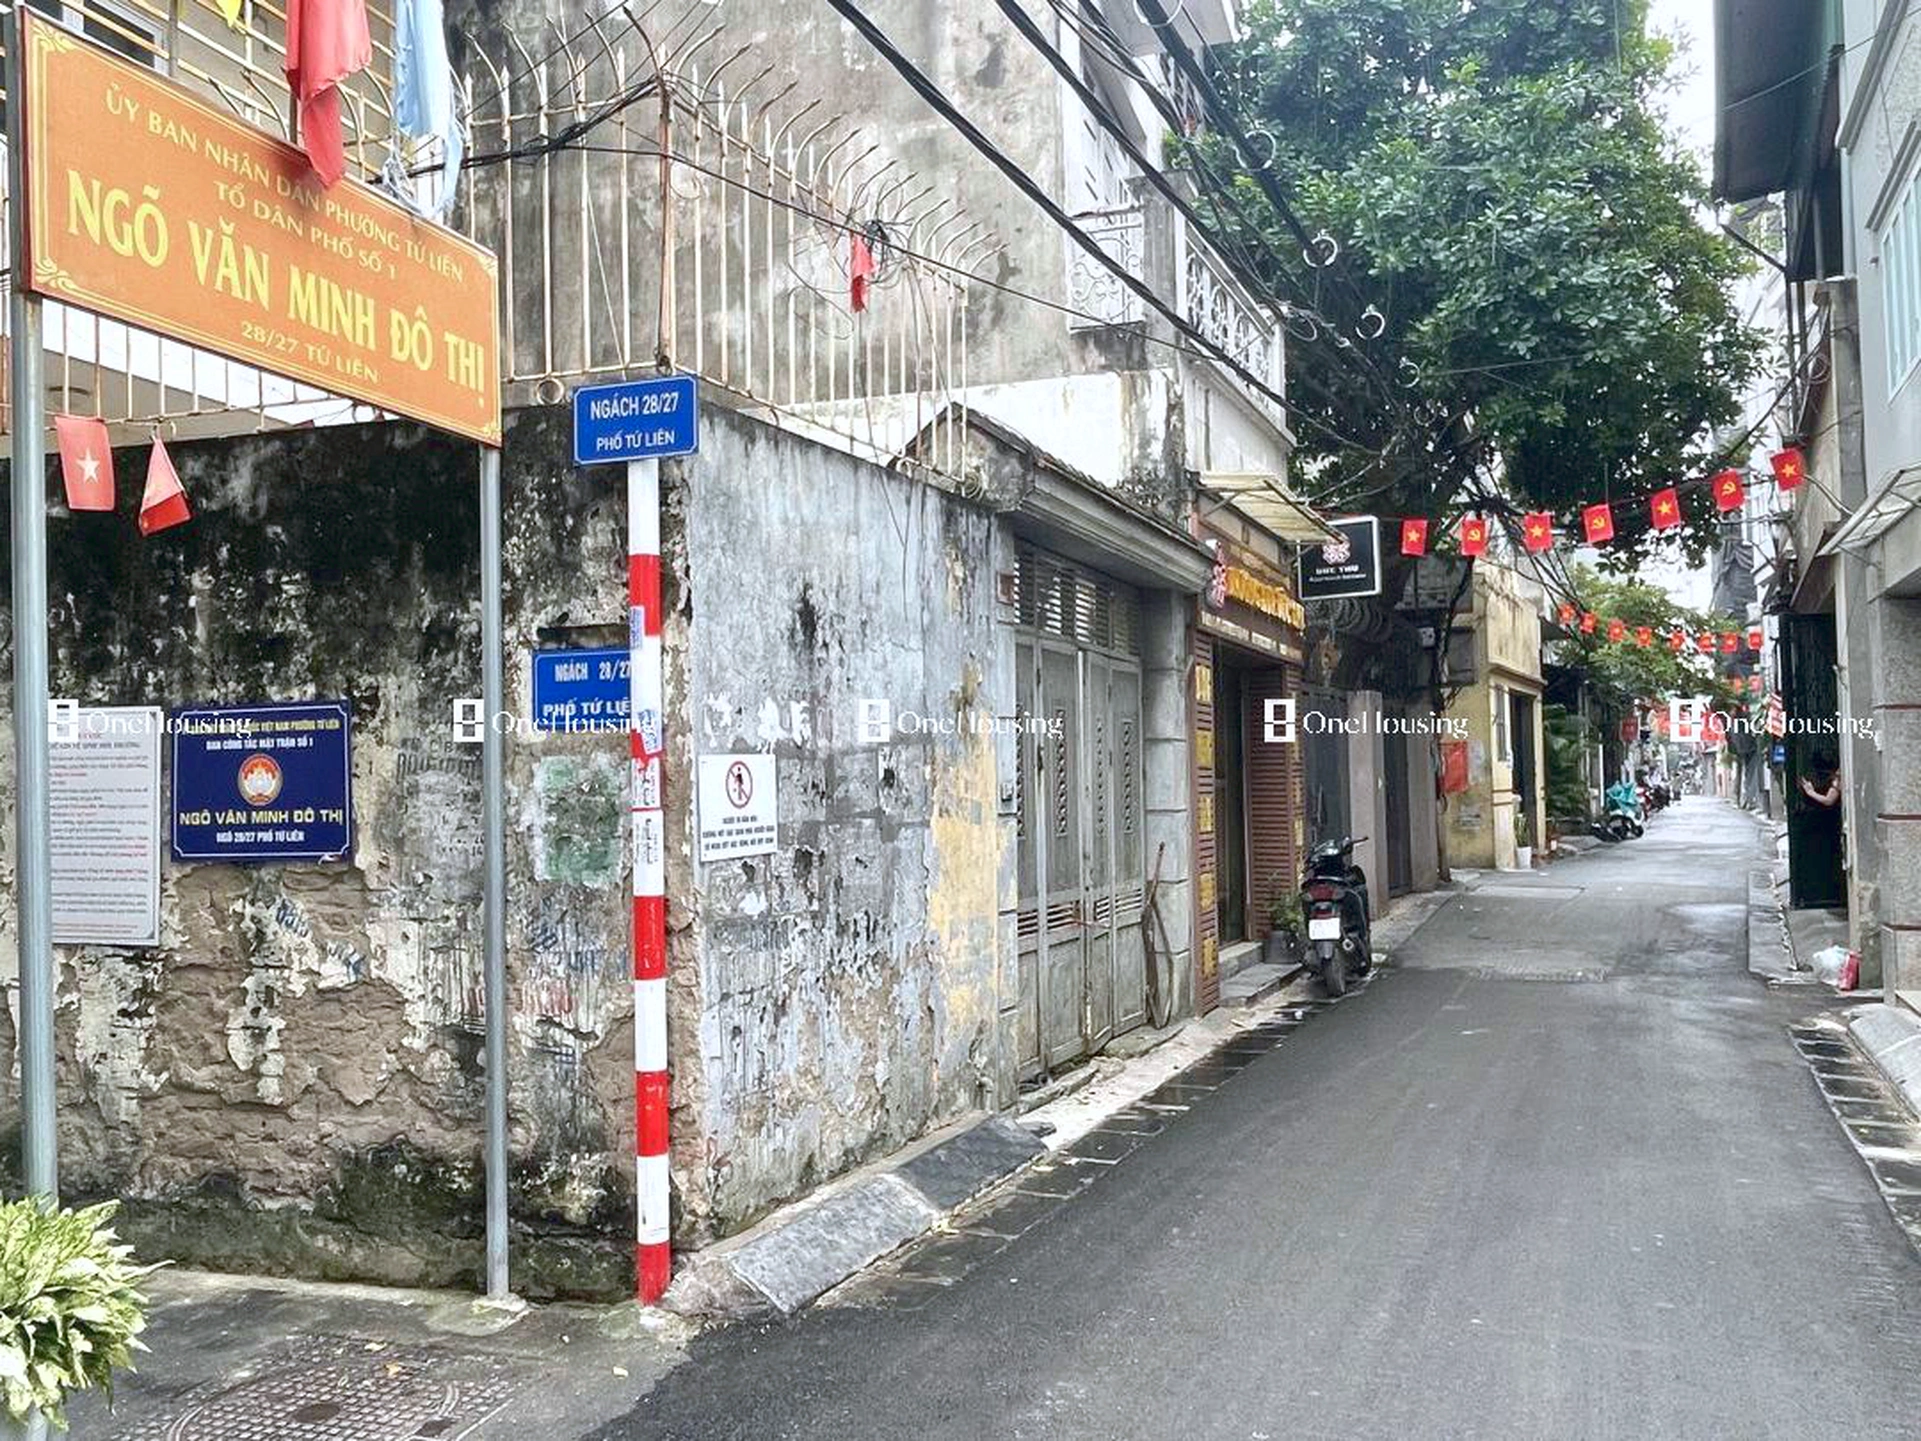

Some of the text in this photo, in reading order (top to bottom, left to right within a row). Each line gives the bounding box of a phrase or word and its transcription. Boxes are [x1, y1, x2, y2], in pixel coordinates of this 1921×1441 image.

[106, 82, 139, 122] ỦY
[149, 111, 198, 152] BAN
[205, 139, 269, 188] NHÂN
[277, 174, 319, 212] DÂN
[326, 199, 400, 251] PHƯỜNG
[430, 253, 463, 283] LIÊN
[213, 180, 395, 280] TỔ DÂN PHỐ SỐ 1
[67, 168, 484, 409] NGÕ VĂN MINH ĐÔ THỊ
[241, 320, 299, 354] 28/27
[335, 355, 379, 384] LIÊN
[590, 391, 679, 420] NGÁCH 28/27
[597, 428, 675, 451] PHỐ TỨ LIÊN
[555, 659, 589, 682] NGÁCH
[543, 697, 631, 717] PHỐ TỨ LIÊ
[252, 810, 289, 825] MINH
[319, 808, 343, 826] THỊ
